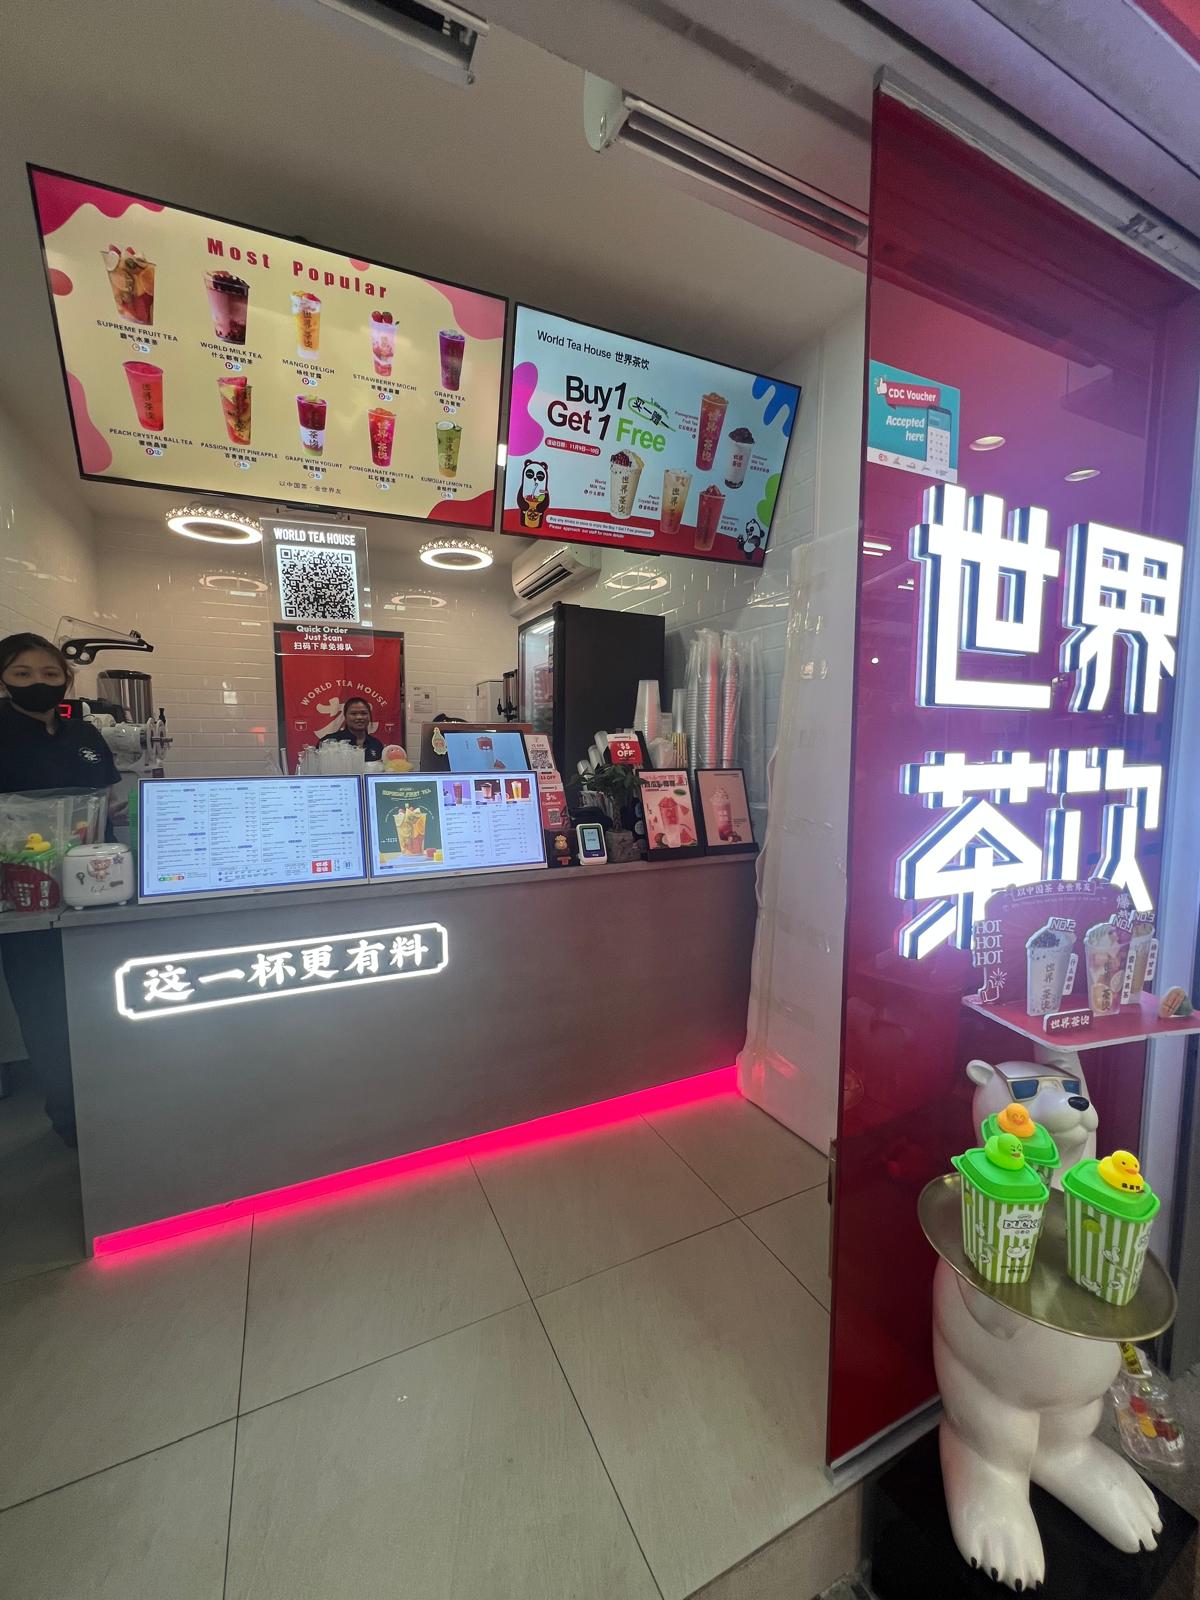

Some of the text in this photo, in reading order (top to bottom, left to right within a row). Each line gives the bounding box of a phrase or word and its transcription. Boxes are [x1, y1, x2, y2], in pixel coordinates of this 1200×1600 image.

[207, 237, 388, 299] Most Popular
[96, 319, 178, 342] SUPREME FRUIT TEA
[200, 341, 263, 360] WORLD MILK TEA
[537, 330, 650, 371] World Tea House 世界茶饮
[282, 358, 335, 375] MANGO DELIGH
[352, 372, 417, 392] STRAWBERRY MOCHI
[434, 390, 455, 401] GRAPE
[888, 387, 937, 402] CDC Voucher
[547, 400, 667, 452] Get 1 Free
[886, 415, 925, 429] Accepted
[109, 427, 193, 446] PEACH CRYSTAL BALL TEA
[905, 430, 925, 442] here
[200, 442, 279, 459] PASSION FRUIT PINEAPPLE
[285, 455, 343, 469] GRAPE WITH YOGURT
[348, 465, 389, 478] POMEGRANATE
[420, 476, 446, 487] KUMQUAT
[446, 480, 463, 488] LEMON
[274, 527, 356, 546] WORLD TEA HOUSE
[908, 482, 1185, 714] 世界
[296, 625, 348, 634] Quick Order
[303, 633, 343, 642] Just Scan
[293, 641, 353, 651] 扫码下单免排队
[300, 682, 333, 706] WORLD
[335, 679, 353, 688] TEA
[356, 683, 388, 707] HOUSE
[617, 749, 633, 757] OFF
[896, 747, 1163, 960] 茶饮
[975, 919, 1002, 934] HOT
[975, 934, 1002, 949] HOT
[975, 949, 1002, 966] HOT
[143, 933, 430, 1001] 这一杯更有料
[1050, 1016, 1090, 1029] 世界茶饮
